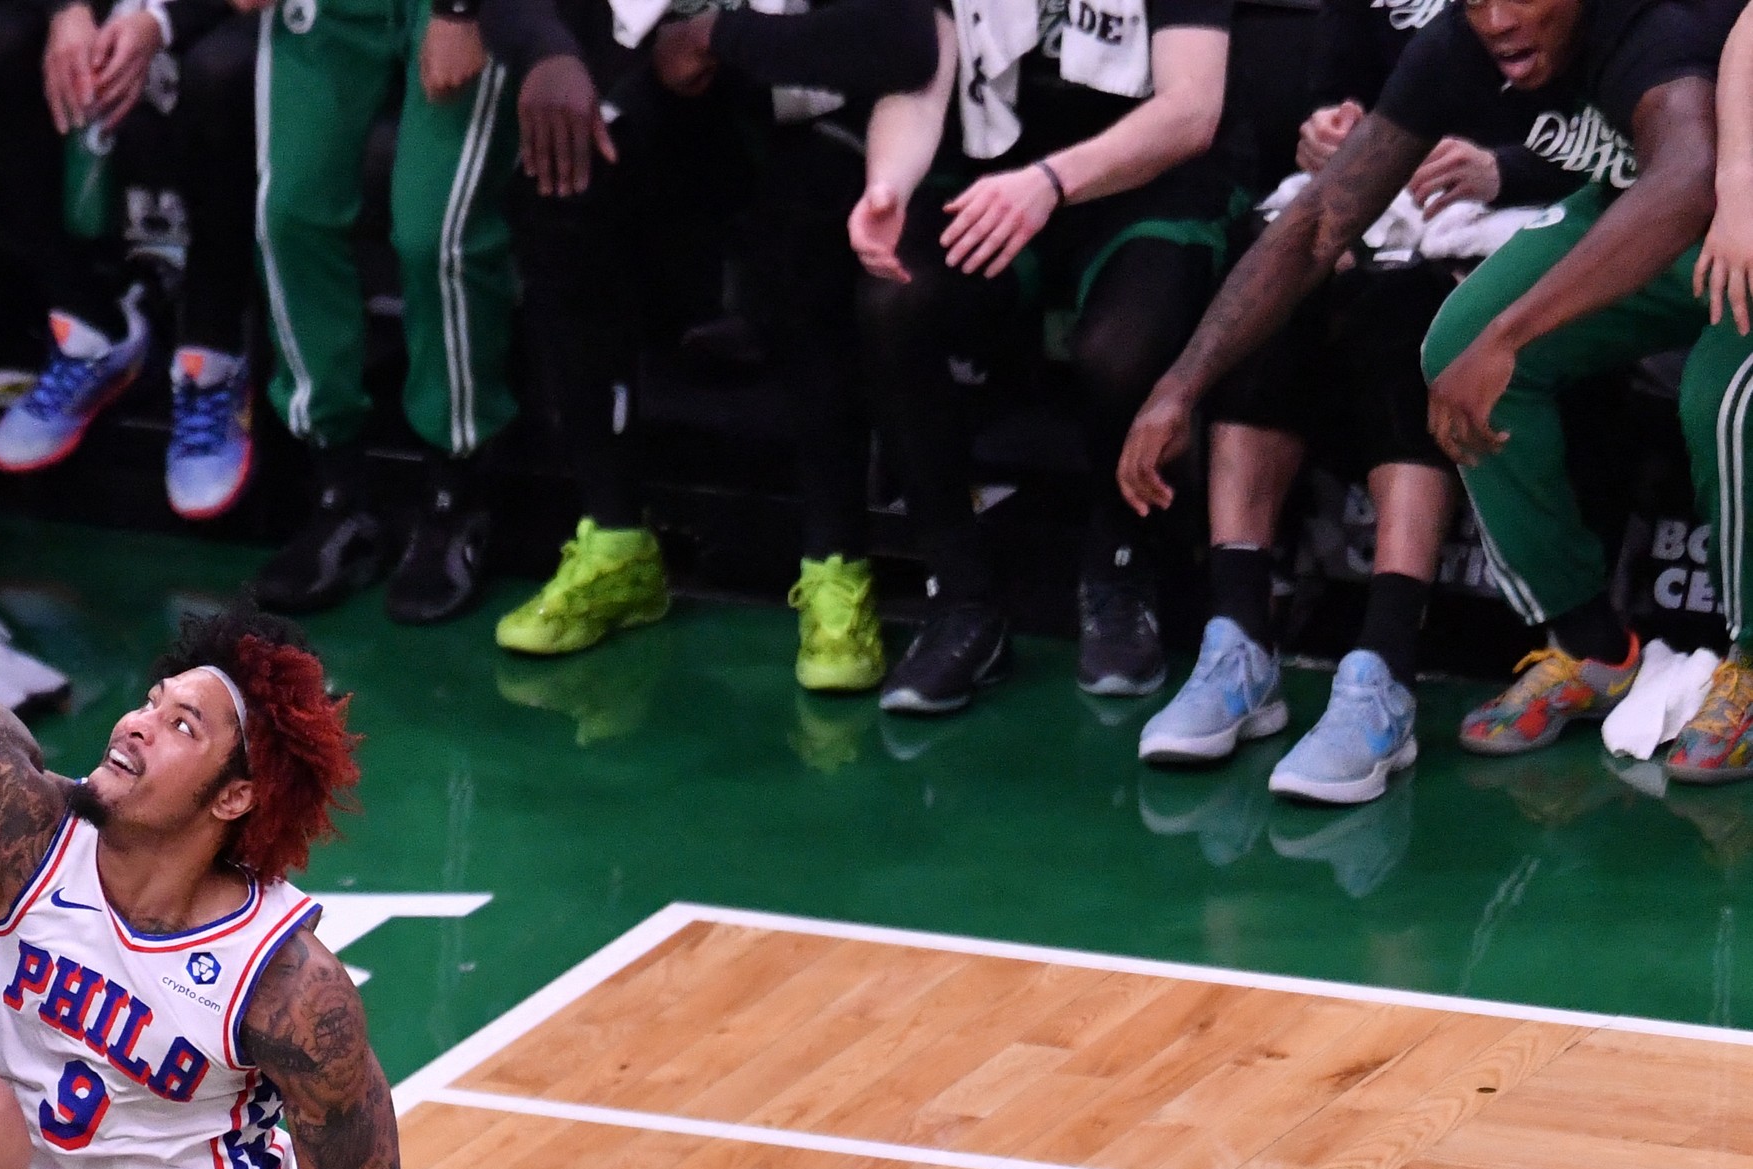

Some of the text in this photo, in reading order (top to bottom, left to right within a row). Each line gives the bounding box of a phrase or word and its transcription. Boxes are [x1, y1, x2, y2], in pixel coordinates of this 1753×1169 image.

[3, 939, 211, 1102] PHILA
[162, 976, 221, 1012] crypto.com
[39, 1060, 111, 1151] 9
